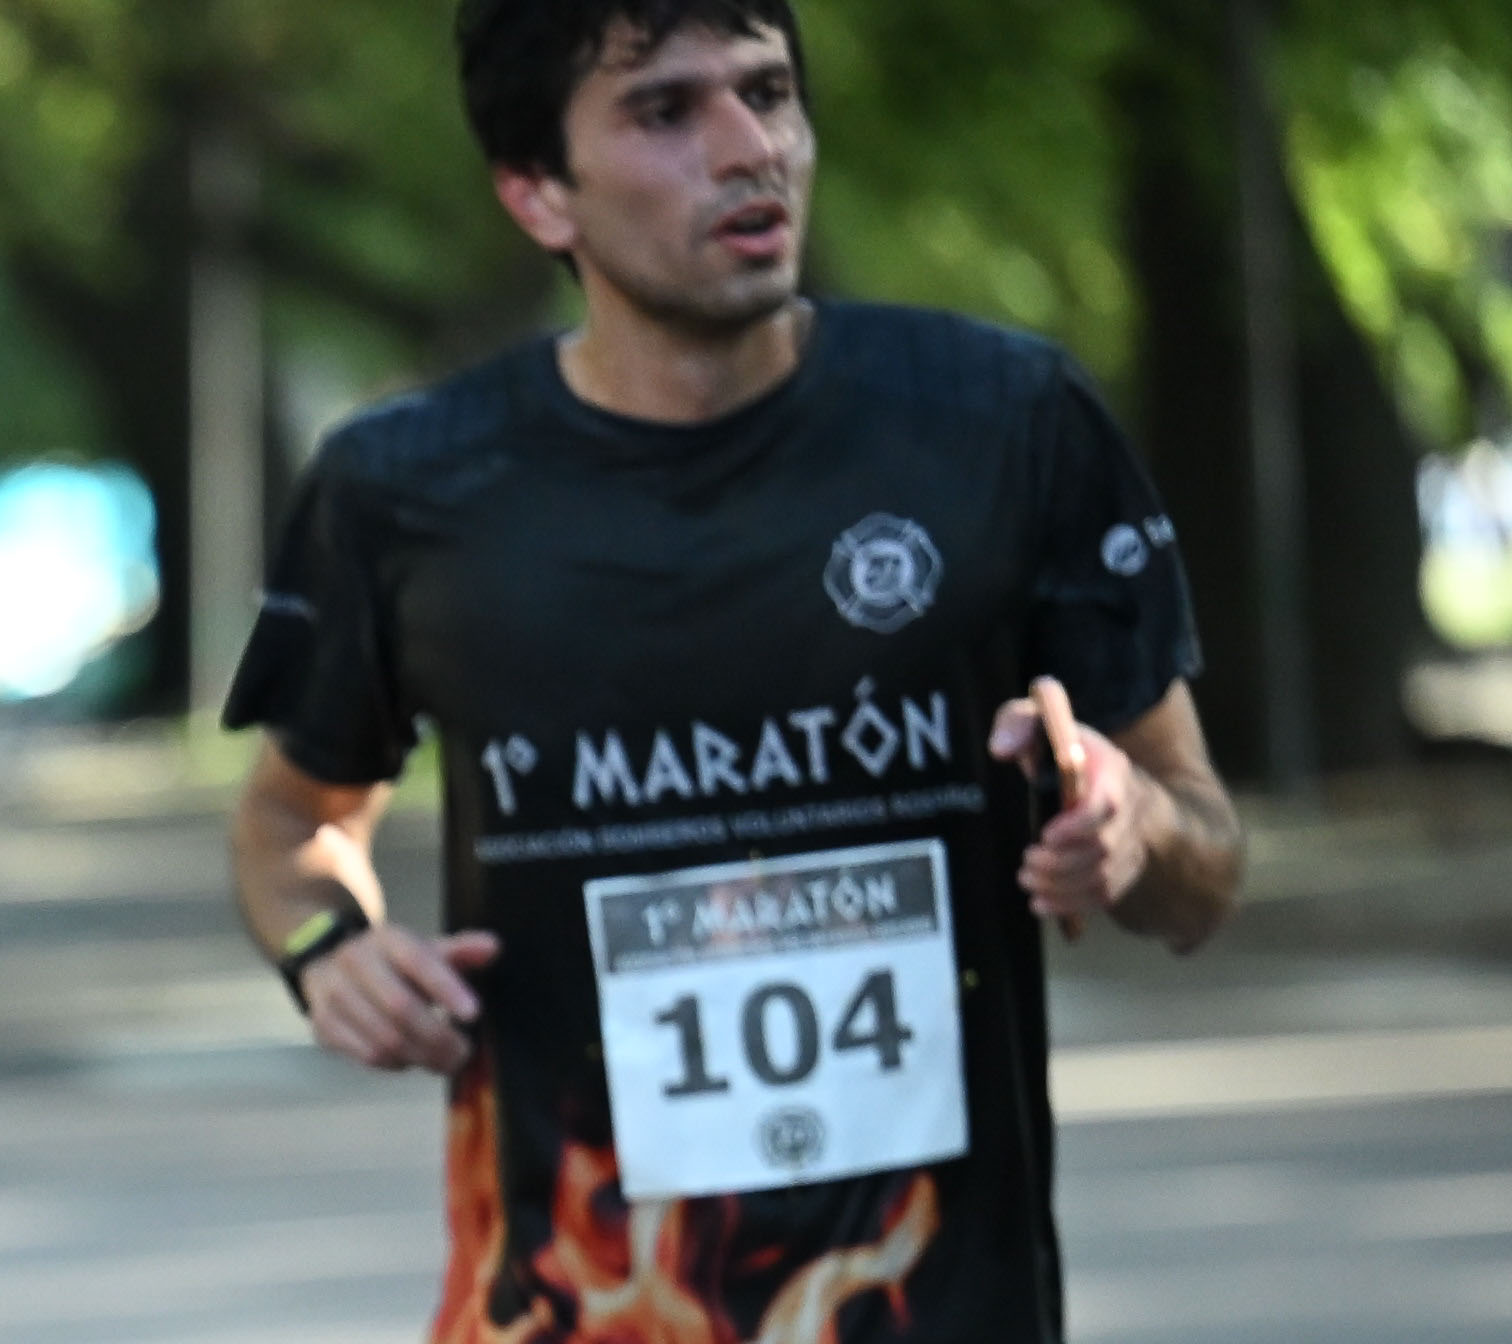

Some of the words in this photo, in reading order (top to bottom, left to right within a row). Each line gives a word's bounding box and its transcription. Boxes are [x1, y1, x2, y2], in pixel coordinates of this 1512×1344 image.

[570, 677, 951, 811] MARATÓN
[692, 864, 899, 940] MARATÓN
[652, 965, 913, 1101] 104
